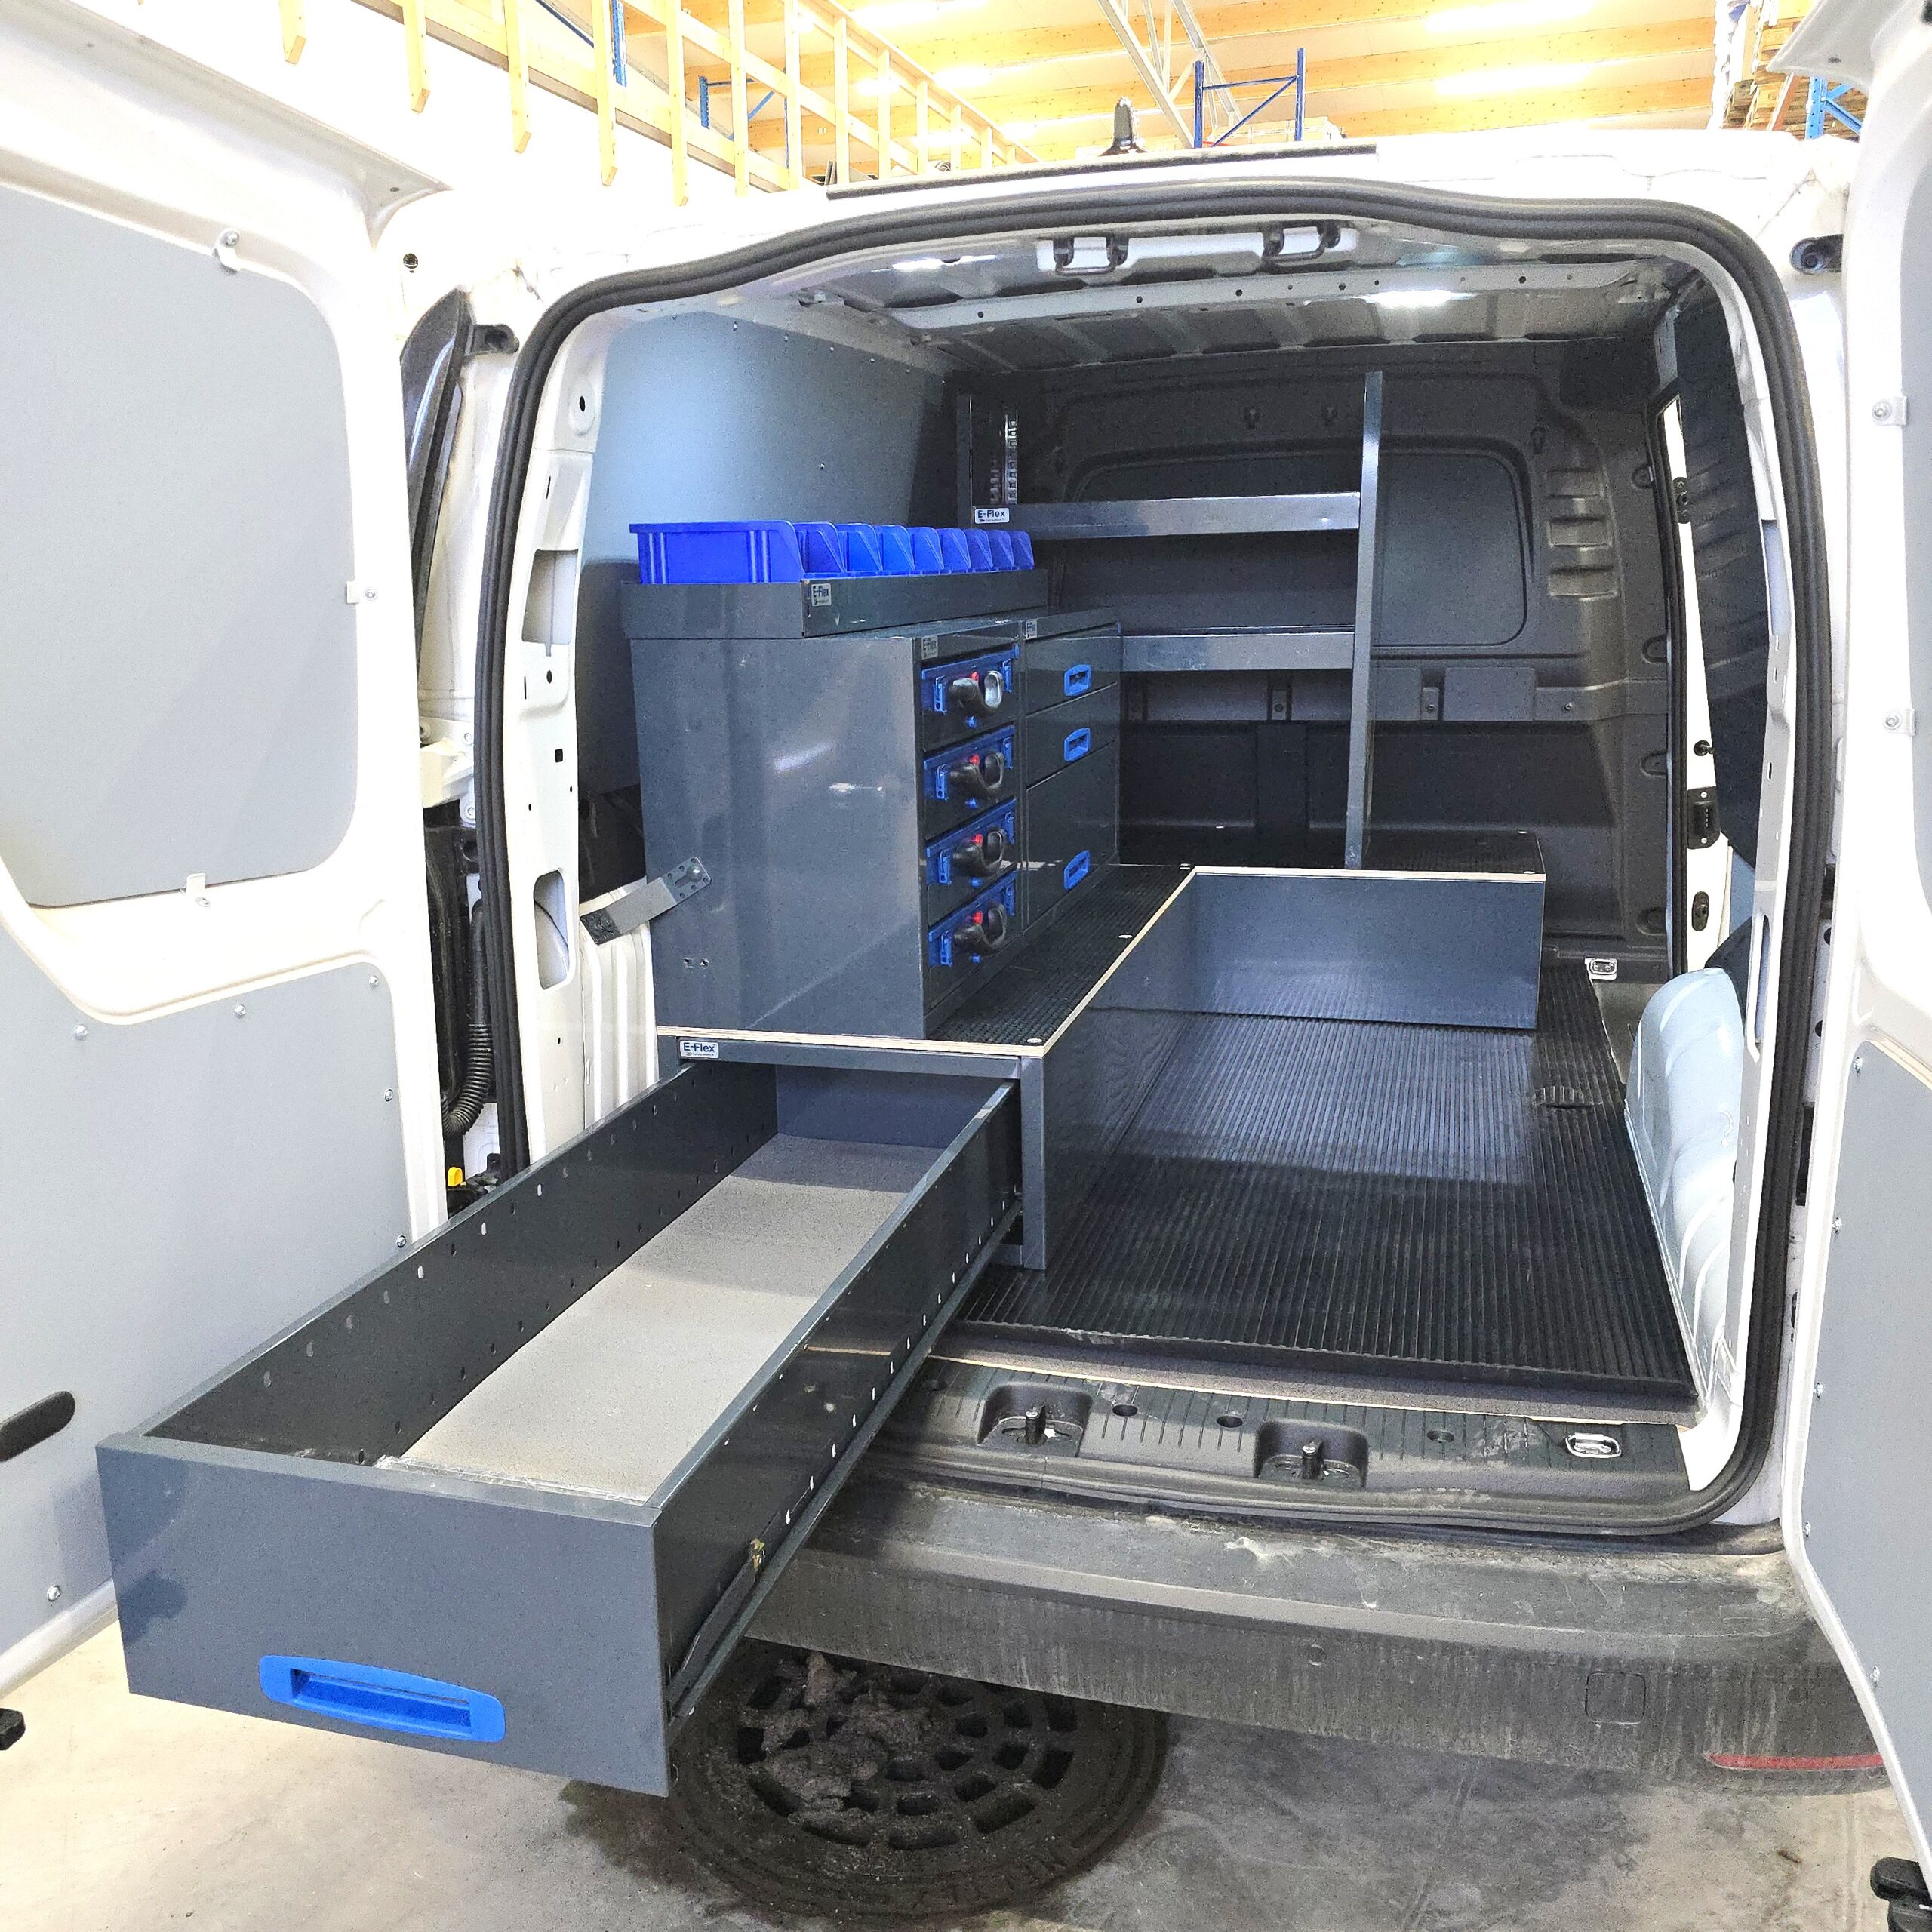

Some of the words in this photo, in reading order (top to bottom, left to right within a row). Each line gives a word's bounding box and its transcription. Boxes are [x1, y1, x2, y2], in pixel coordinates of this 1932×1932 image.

[977, 509, 1005, 518] E-Flex
[813, 586, 829, 597] E-Flex
[683, 1042, 715, 1052] E-Flex
